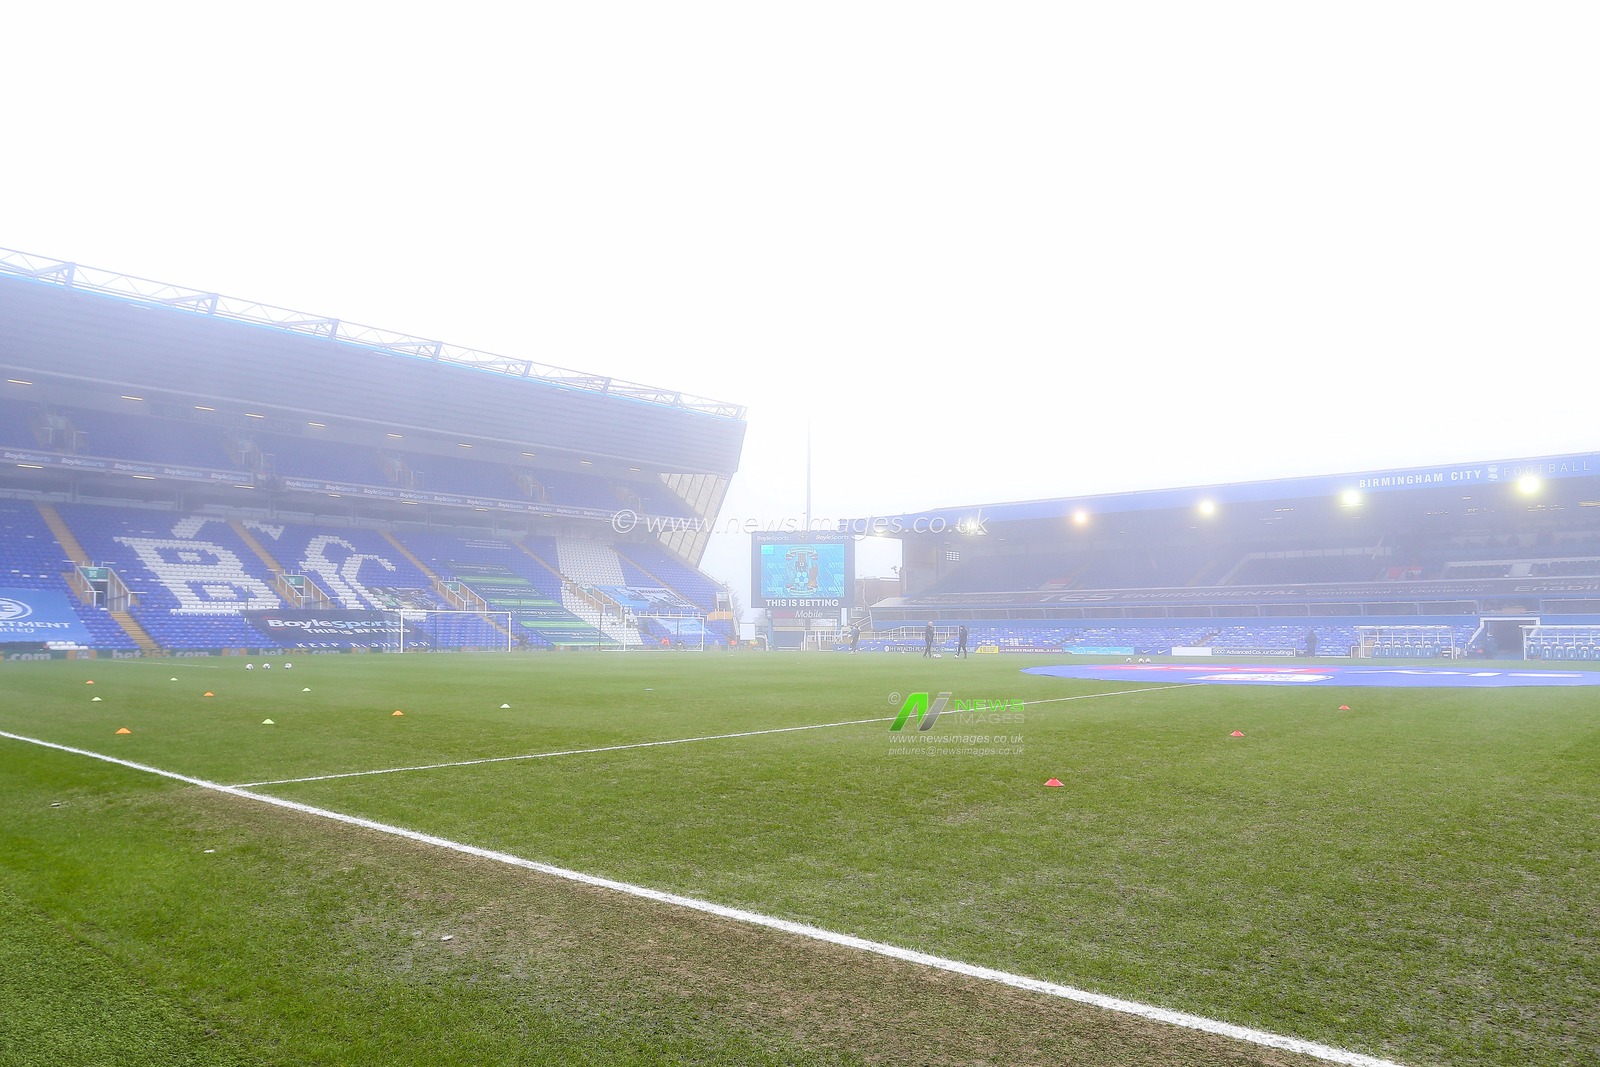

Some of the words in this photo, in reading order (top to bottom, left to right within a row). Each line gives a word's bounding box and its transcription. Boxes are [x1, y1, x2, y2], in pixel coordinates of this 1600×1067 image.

[4, 451, 51, 463] BoyleSports
[61, 457, 105, 468] BoyleSports
[114, 463, 156, 473] BoyleSports
[164, 468, 203, 478] BoyleSports
[211, 473, 247, 482] BoyleSports
[1503, 461, 1590, 477] FOOTBALL
[1359, 472, 1443, 488] BIRMINGHAM
[1450, 470, 1481, 481] CITY
[285, 480, 319, 489] BoyleSports
[325, 484, 357, 493] BoyleSports
[363, 488, 394, 497] BoyleSports
[399, 492, 429, 500] BoyleSports
[434, 496, 462, 504] BoyleSports
[1121, 590, 1299, 600] ENVIRONMENTAL
[765, 599, 787, 607] THIS
[788, 599, 798, 607] IS
[799, 599, 839, 607] BETTING
[795, 610, 824, 618] Mobile
[267, 618, 405, 629] BoyleSports
